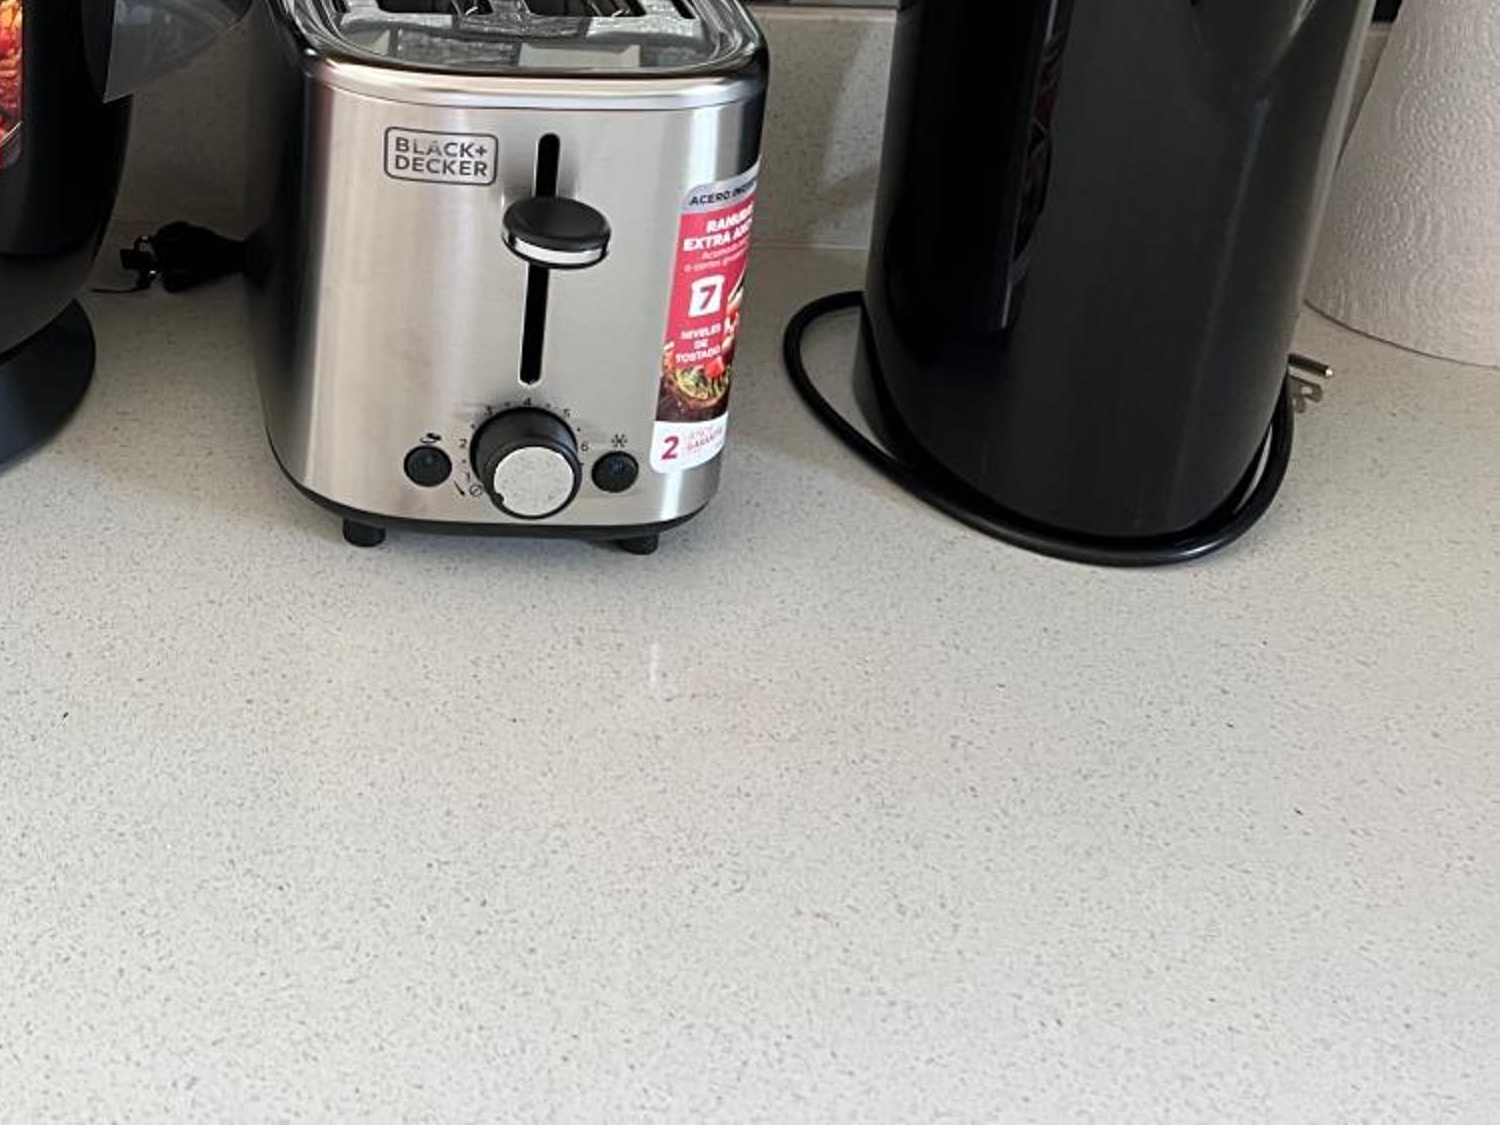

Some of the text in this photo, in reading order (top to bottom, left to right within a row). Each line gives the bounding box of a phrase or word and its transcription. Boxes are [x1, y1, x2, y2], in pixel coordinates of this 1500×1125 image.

[395, 136, 487, 158] BLACK+
[395, 154, 488, 177] DECKER
[689, 190, 731, 206] ACERO
[683, 229, 731, 252] EXTRA
[700, 284, 718, 310] 7
[681, 322, 721, 340] NIVELES
[675, 344, 721, 363] TOSTADO
[693, 338, 708, 350] DE
[661, 435, 679, 460] 2
